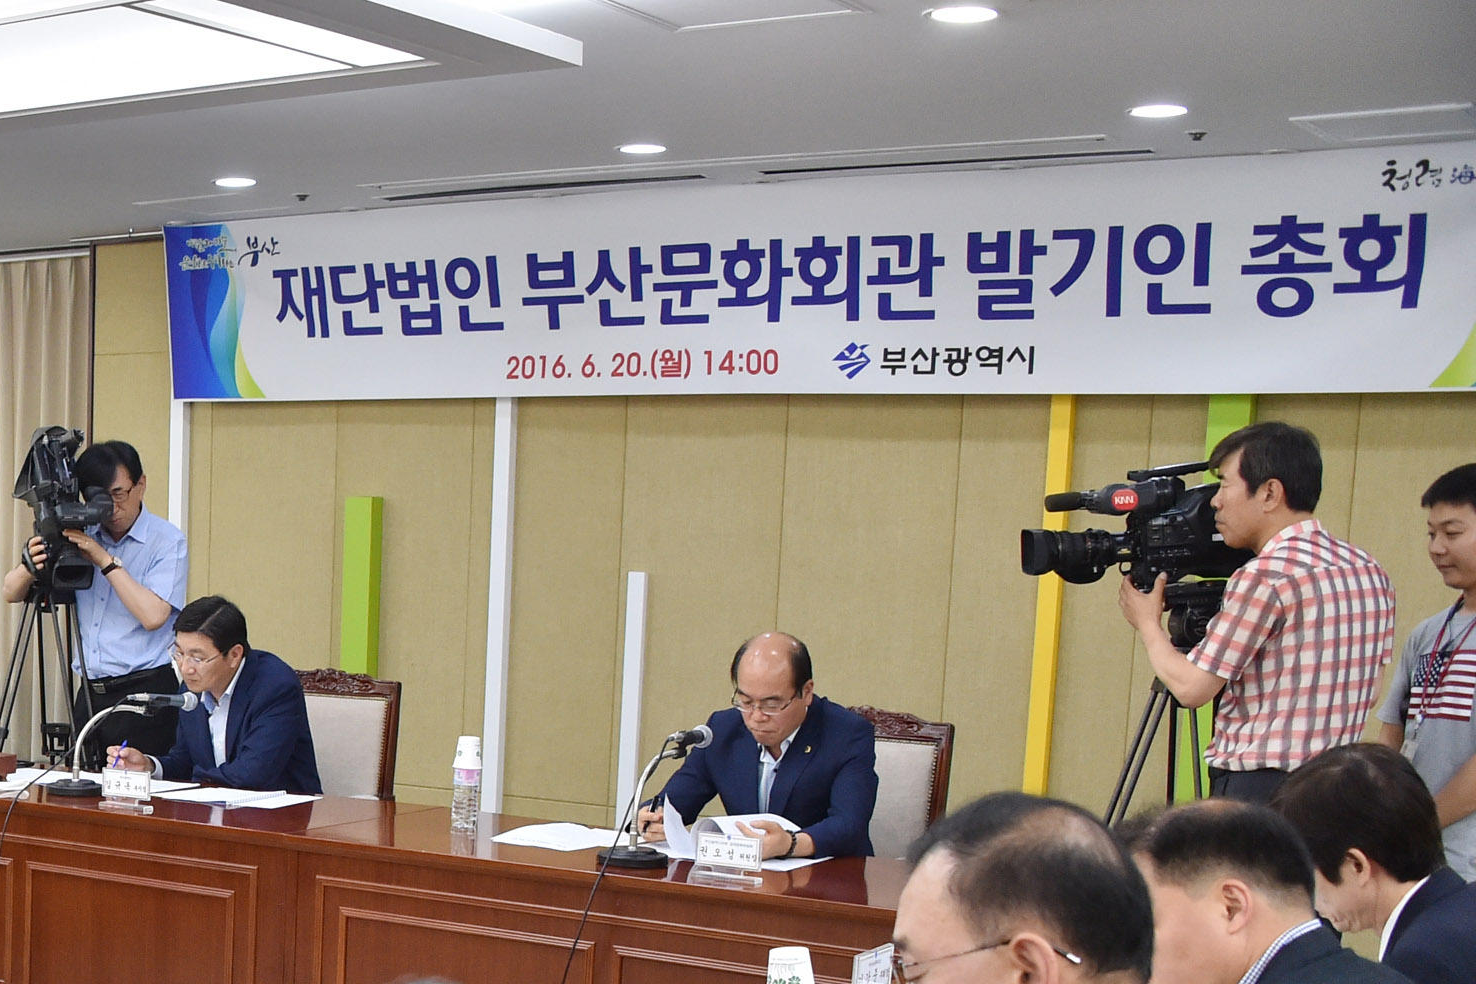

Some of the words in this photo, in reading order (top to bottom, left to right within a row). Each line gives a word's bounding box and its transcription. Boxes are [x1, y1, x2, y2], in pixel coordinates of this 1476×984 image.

[237, 235, 281, 268] 부산
[272, 254, 505, 339] 재단법인
[522, 231, 945, 332] 부산문화회관
[965, 221, 1213, 321] 발기인
[1240, 211, 1428, 318] 총회
[506, 355, 572, 381] 2016.
[581, 353, 606, 379] 6.
[611, 348, 692, 380] 20.(월)
[704, 348, 780, 376] 14:00
[880, 344, 1036, 377] 부산광역시
[1114, 495, 1135, 505] KNN
